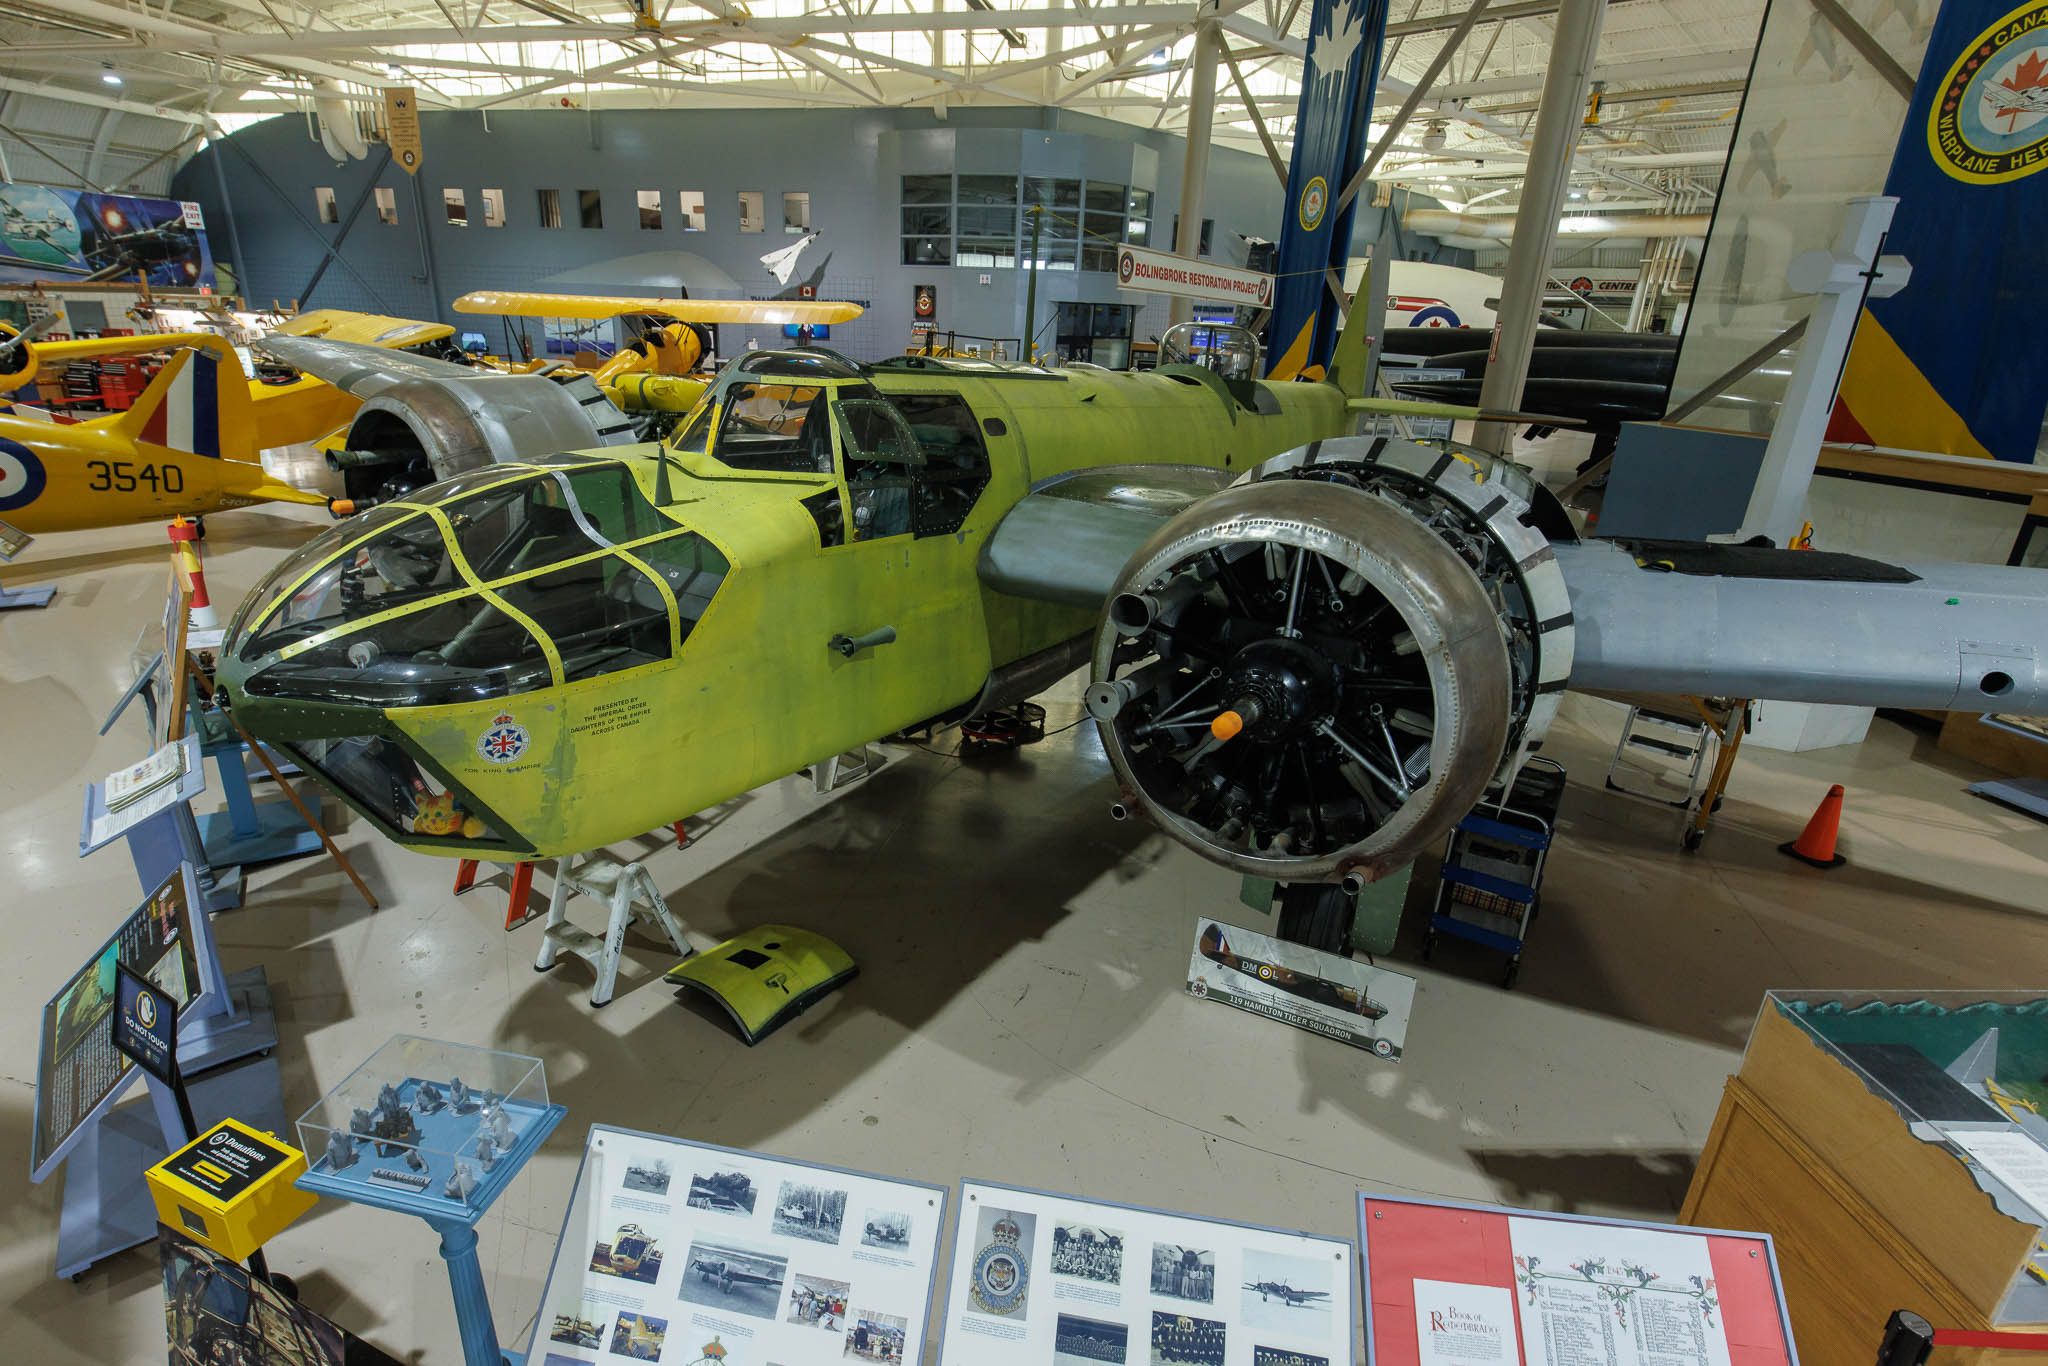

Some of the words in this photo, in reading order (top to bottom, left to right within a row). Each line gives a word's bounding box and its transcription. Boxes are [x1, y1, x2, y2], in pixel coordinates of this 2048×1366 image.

[1939, 113, 2000, 173] WARPLANE
[1135, 262, 1188, 284] BOLINGBROKE
[1189, 272, 1232, 291] RESTORATION
[1233, 280, 1259, 295] PROJECT
[1598, 281, 1637, 290] CENTRE
[87, 460, 184, 493] 3540
[584, 714, 596, 722] THE
[598, 707, 625, 718] IMPERIAL
[627, 701, 647, 711] ORDER
[593, 698, 629, 712] PRESENTED
[570, 720, 606, 734] DAUGHTERS
[617, 714, 628, 722] THE
[629, 708, 651, 719] EMPIRE
[591, 725, 615, 736] ACROSS
[616, 719, 640, 730] CANADA
[1241, 960, 1258, 972] DM
[1271, 970, 1279, 980] L
[1230, 995, 1243, 1005] 119
[1243, 998, 1283, 1018] HAMILTON
[1283, 1012, 1308, 1026] TIGER
[1308, 1018, 1352, 1039] SQUADRON
[125, 1016, 135, 1028] DO
[135, 1022, 148, 1038] NOT
[148, 1031, 168, 1053] TOUCH
[224, 1137, 266, 1162] Donations
